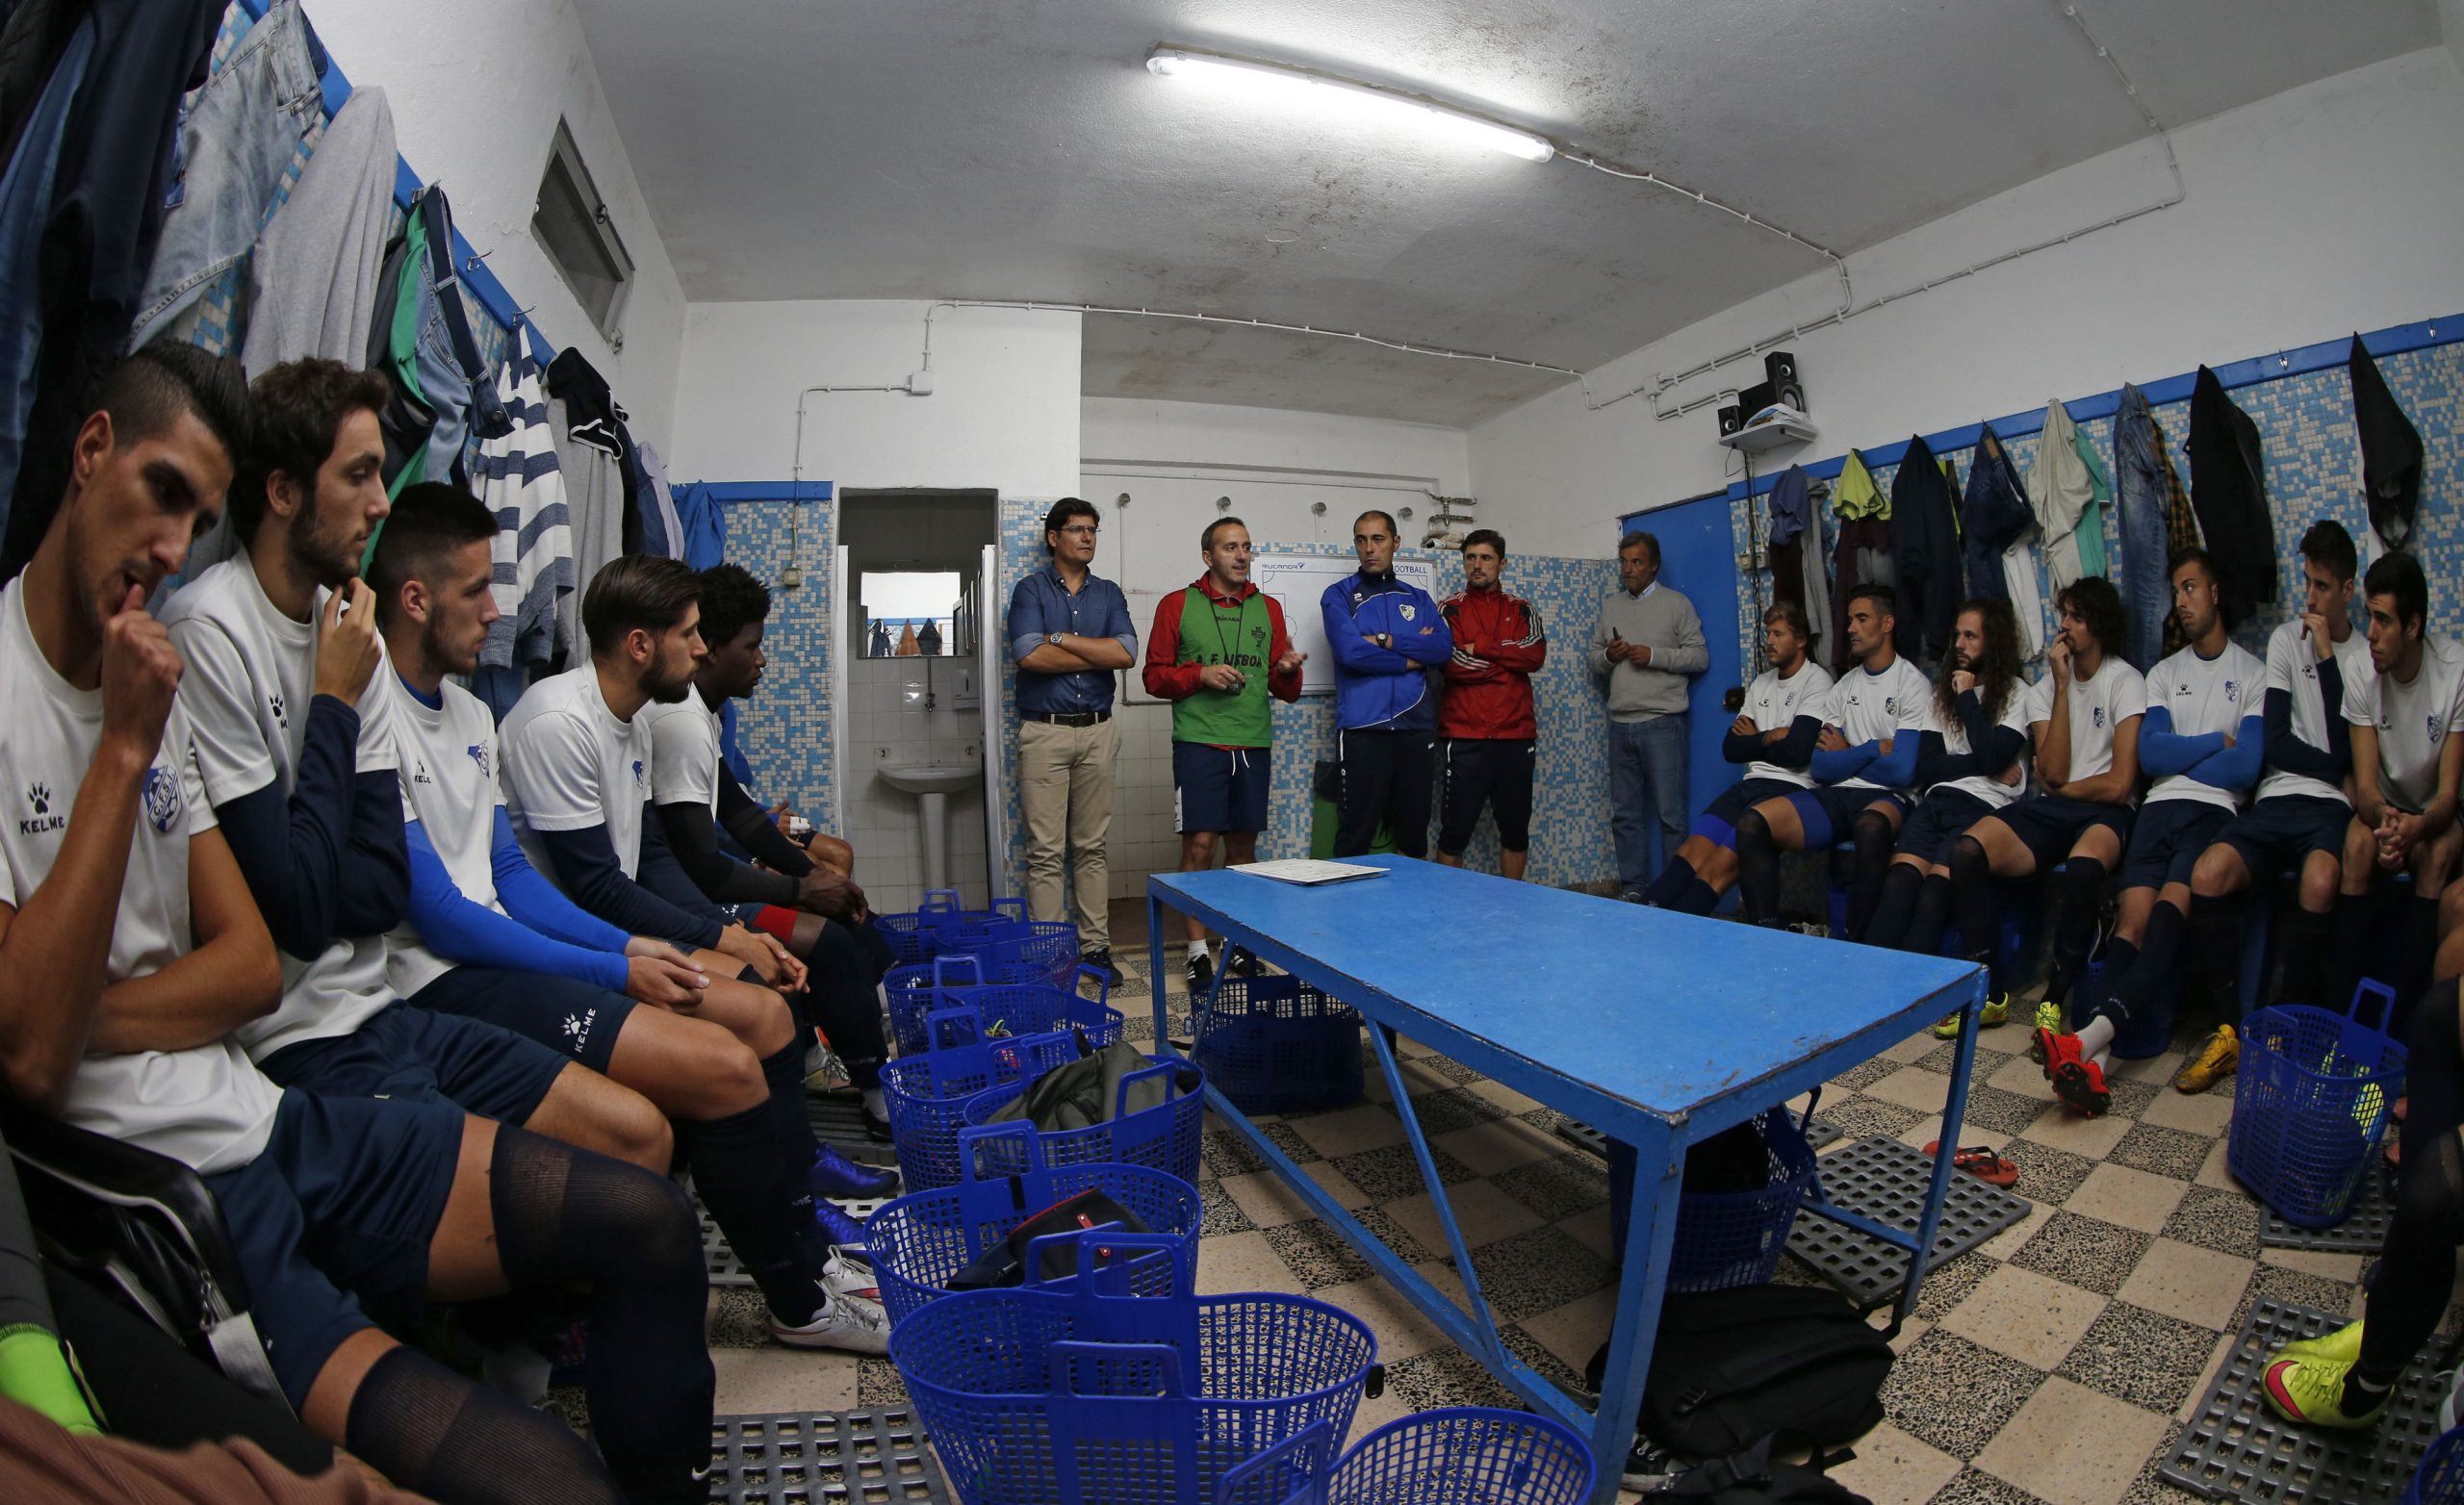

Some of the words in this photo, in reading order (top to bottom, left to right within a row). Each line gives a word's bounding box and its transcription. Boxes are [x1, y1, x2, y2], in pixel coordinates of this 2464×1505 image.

[1394, 565, 1427, 574] OOTBALL
[19, 816, 65, 835] KELME
[575, 1008, 596, 1054] KELME
